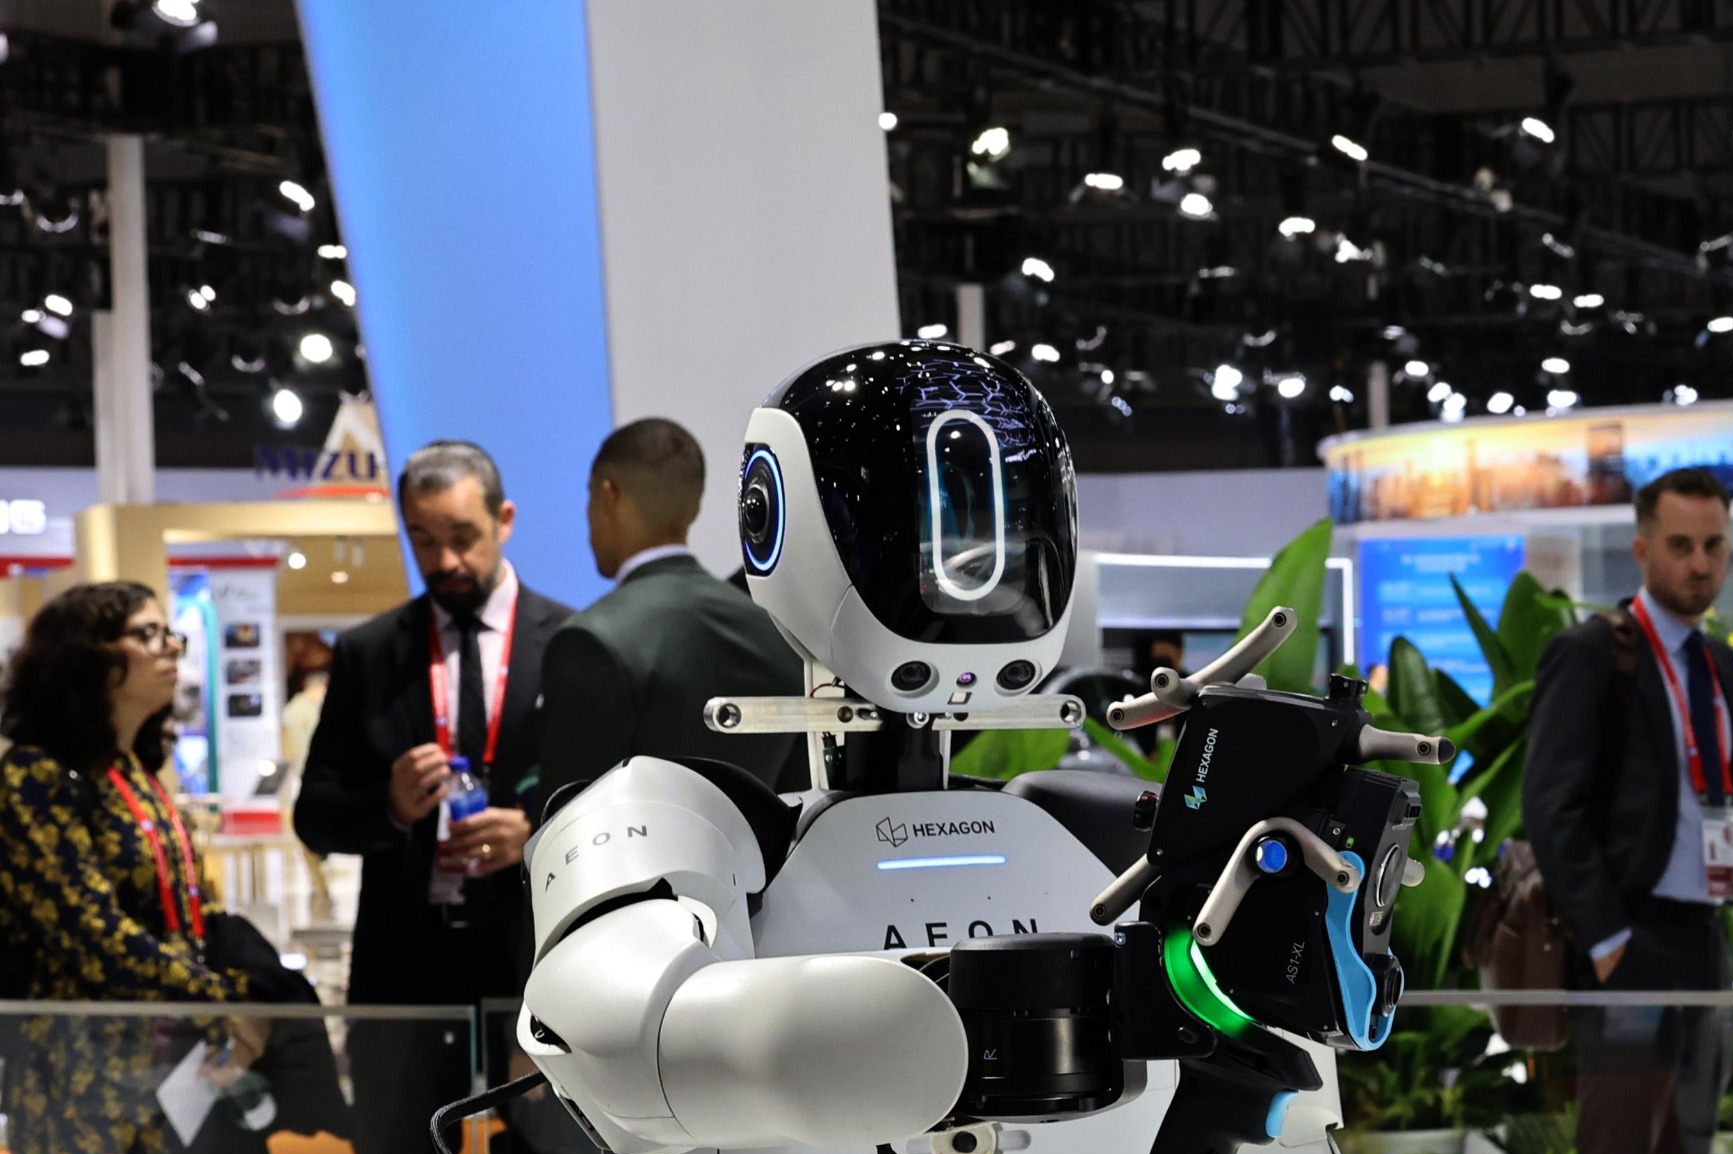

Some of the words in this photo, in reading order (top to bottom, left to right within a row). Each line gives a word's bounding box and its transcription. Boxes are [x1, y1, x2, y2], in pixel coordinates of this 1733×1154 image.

[1196, 728, 1219, 783] HEXAGON
[912, 820, 996, 838] HEXAGON
[544, 825, 648, 893] AEON
[1285, 941, 1306, 985] AS1-XL
